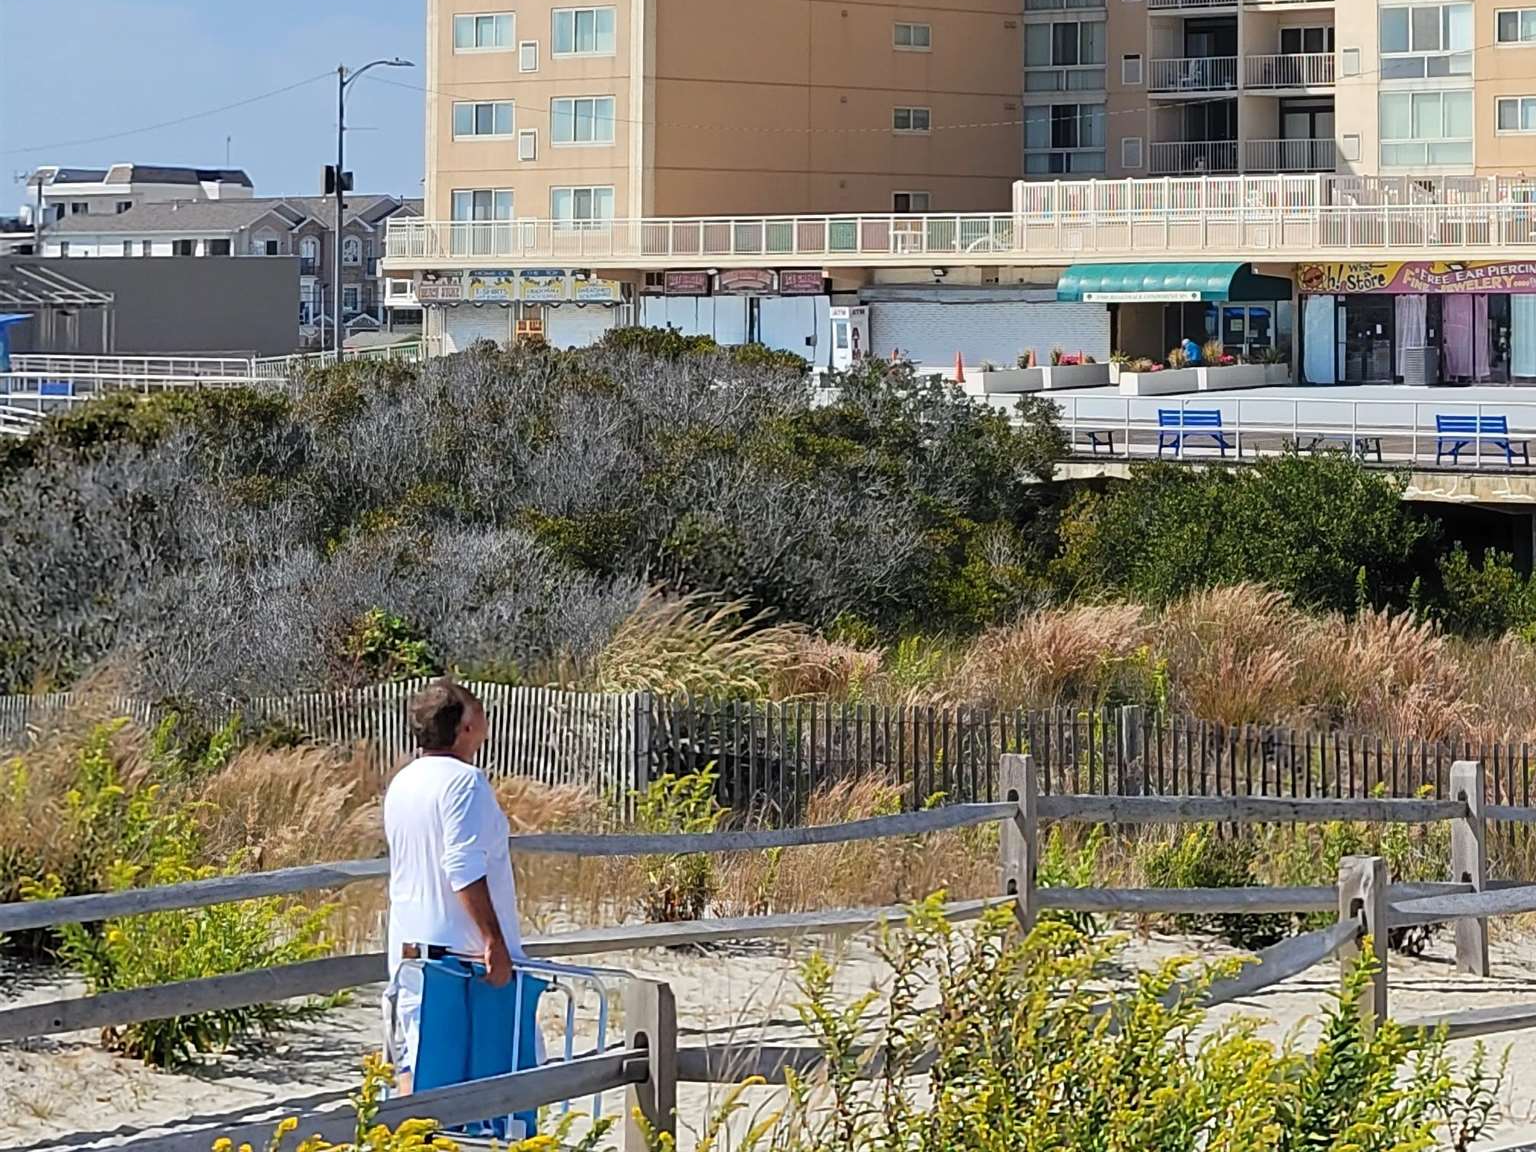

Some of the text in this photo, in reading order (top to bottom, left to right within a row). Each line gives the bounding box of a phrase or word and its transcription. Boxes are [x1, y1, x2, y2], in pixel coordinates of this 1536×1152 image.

[1346, 272, 1386, 290] Store
[1402, 268, 1430, 292] FINE
[1419, 269, 1450, 285] FREE
[1455, 268, 1486, 282] EAR
